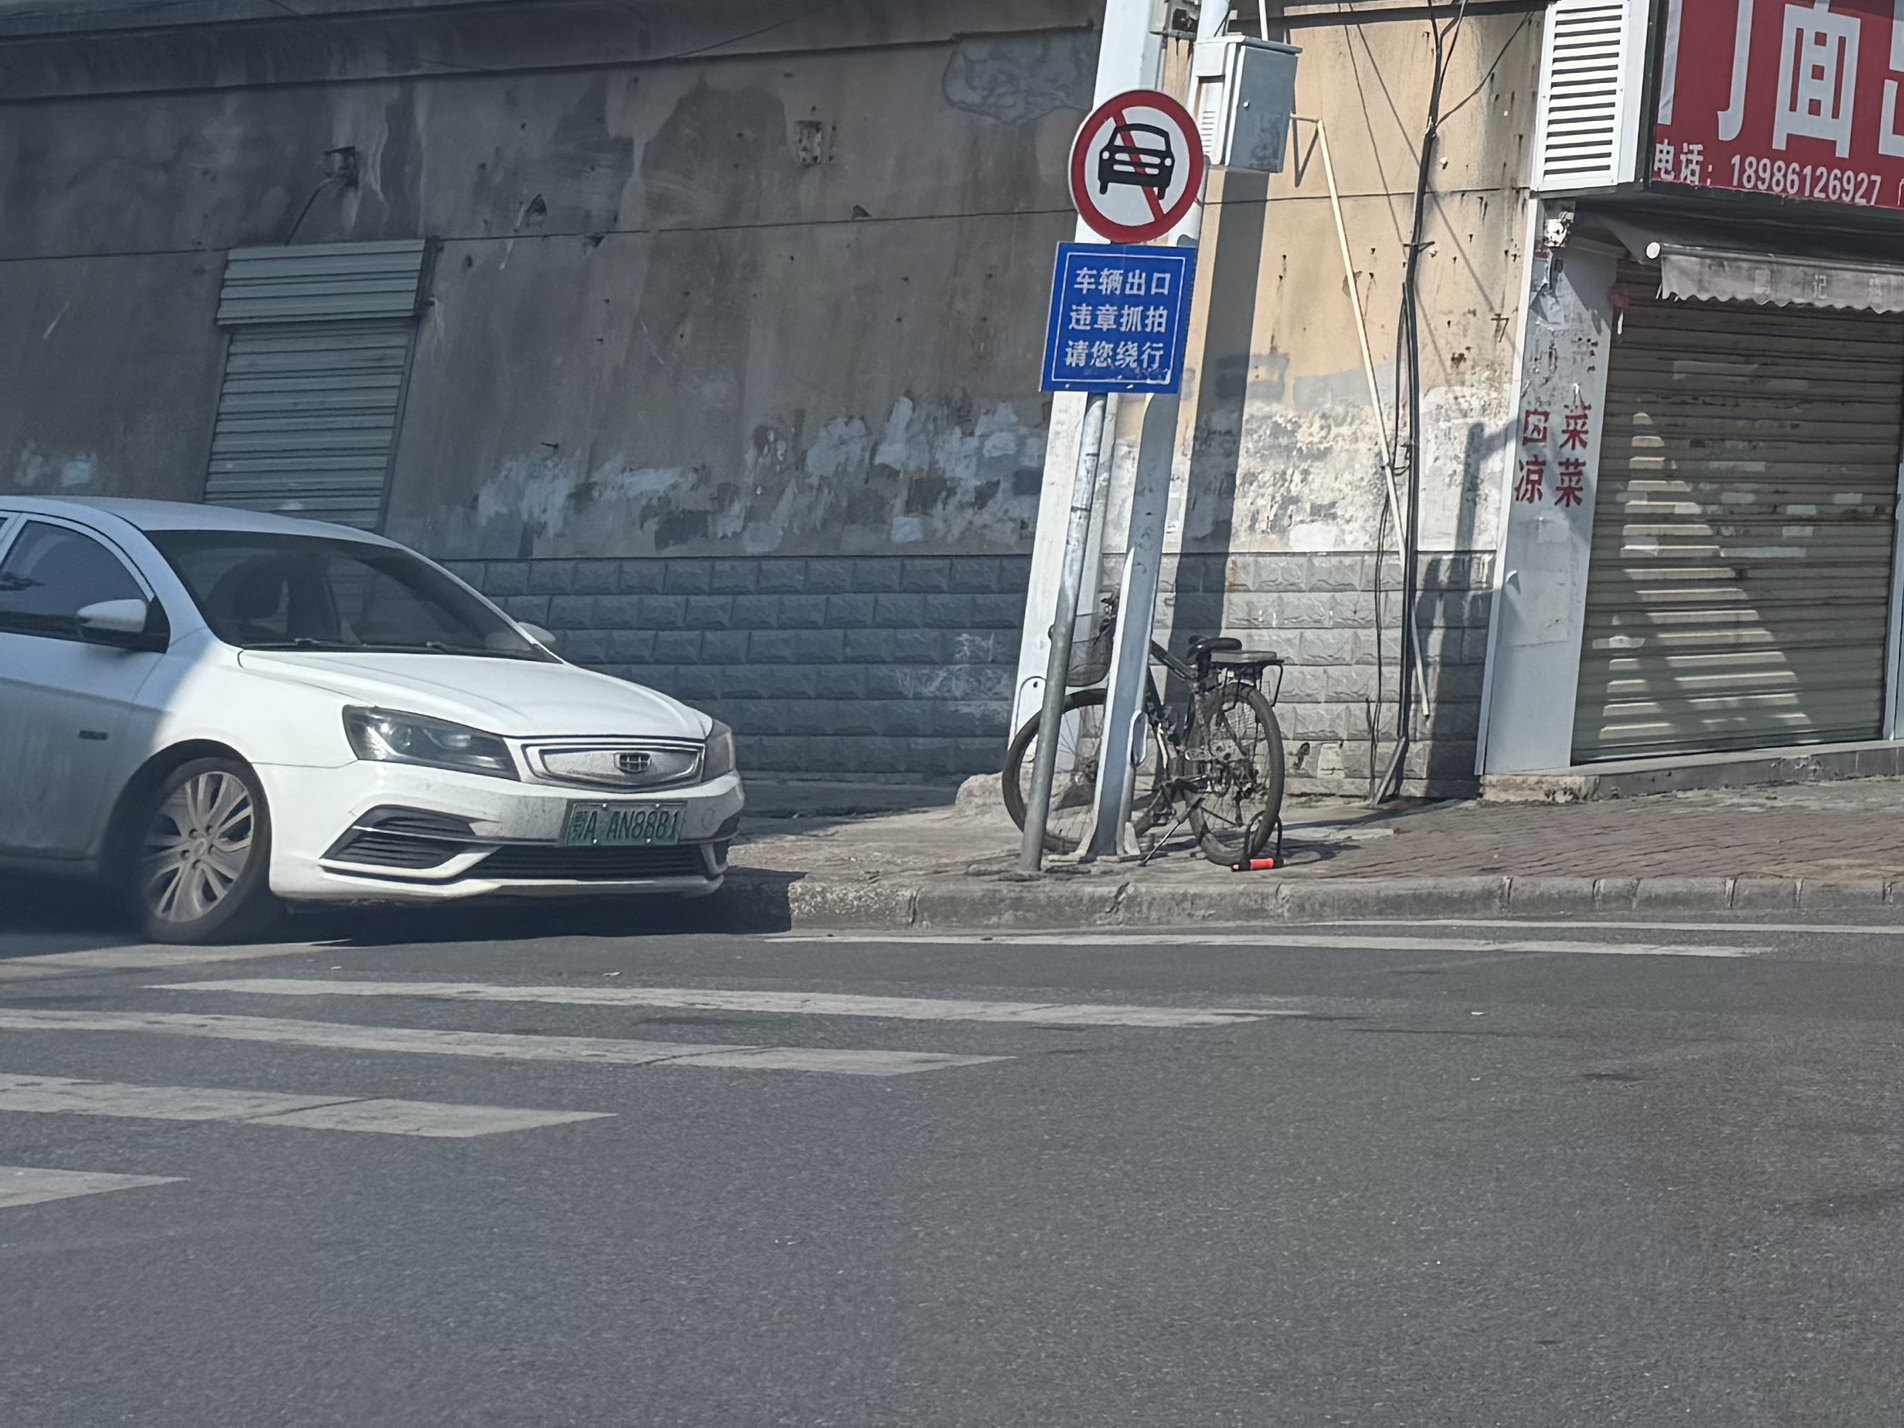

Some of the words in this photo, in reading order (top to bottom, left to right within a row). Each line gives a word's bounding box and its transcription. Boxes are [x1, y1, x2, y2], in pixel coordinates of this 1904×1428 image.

[1730, 154, 1882, 205] 18986126927
[1073, 266, 1171, 296] 车辆出口
[1068, 303, 1168, 333] 违章抓拍
[1065, 339, 1164, 370] 请您绕行
[1515, 454, 1587, 508] 凉菜
